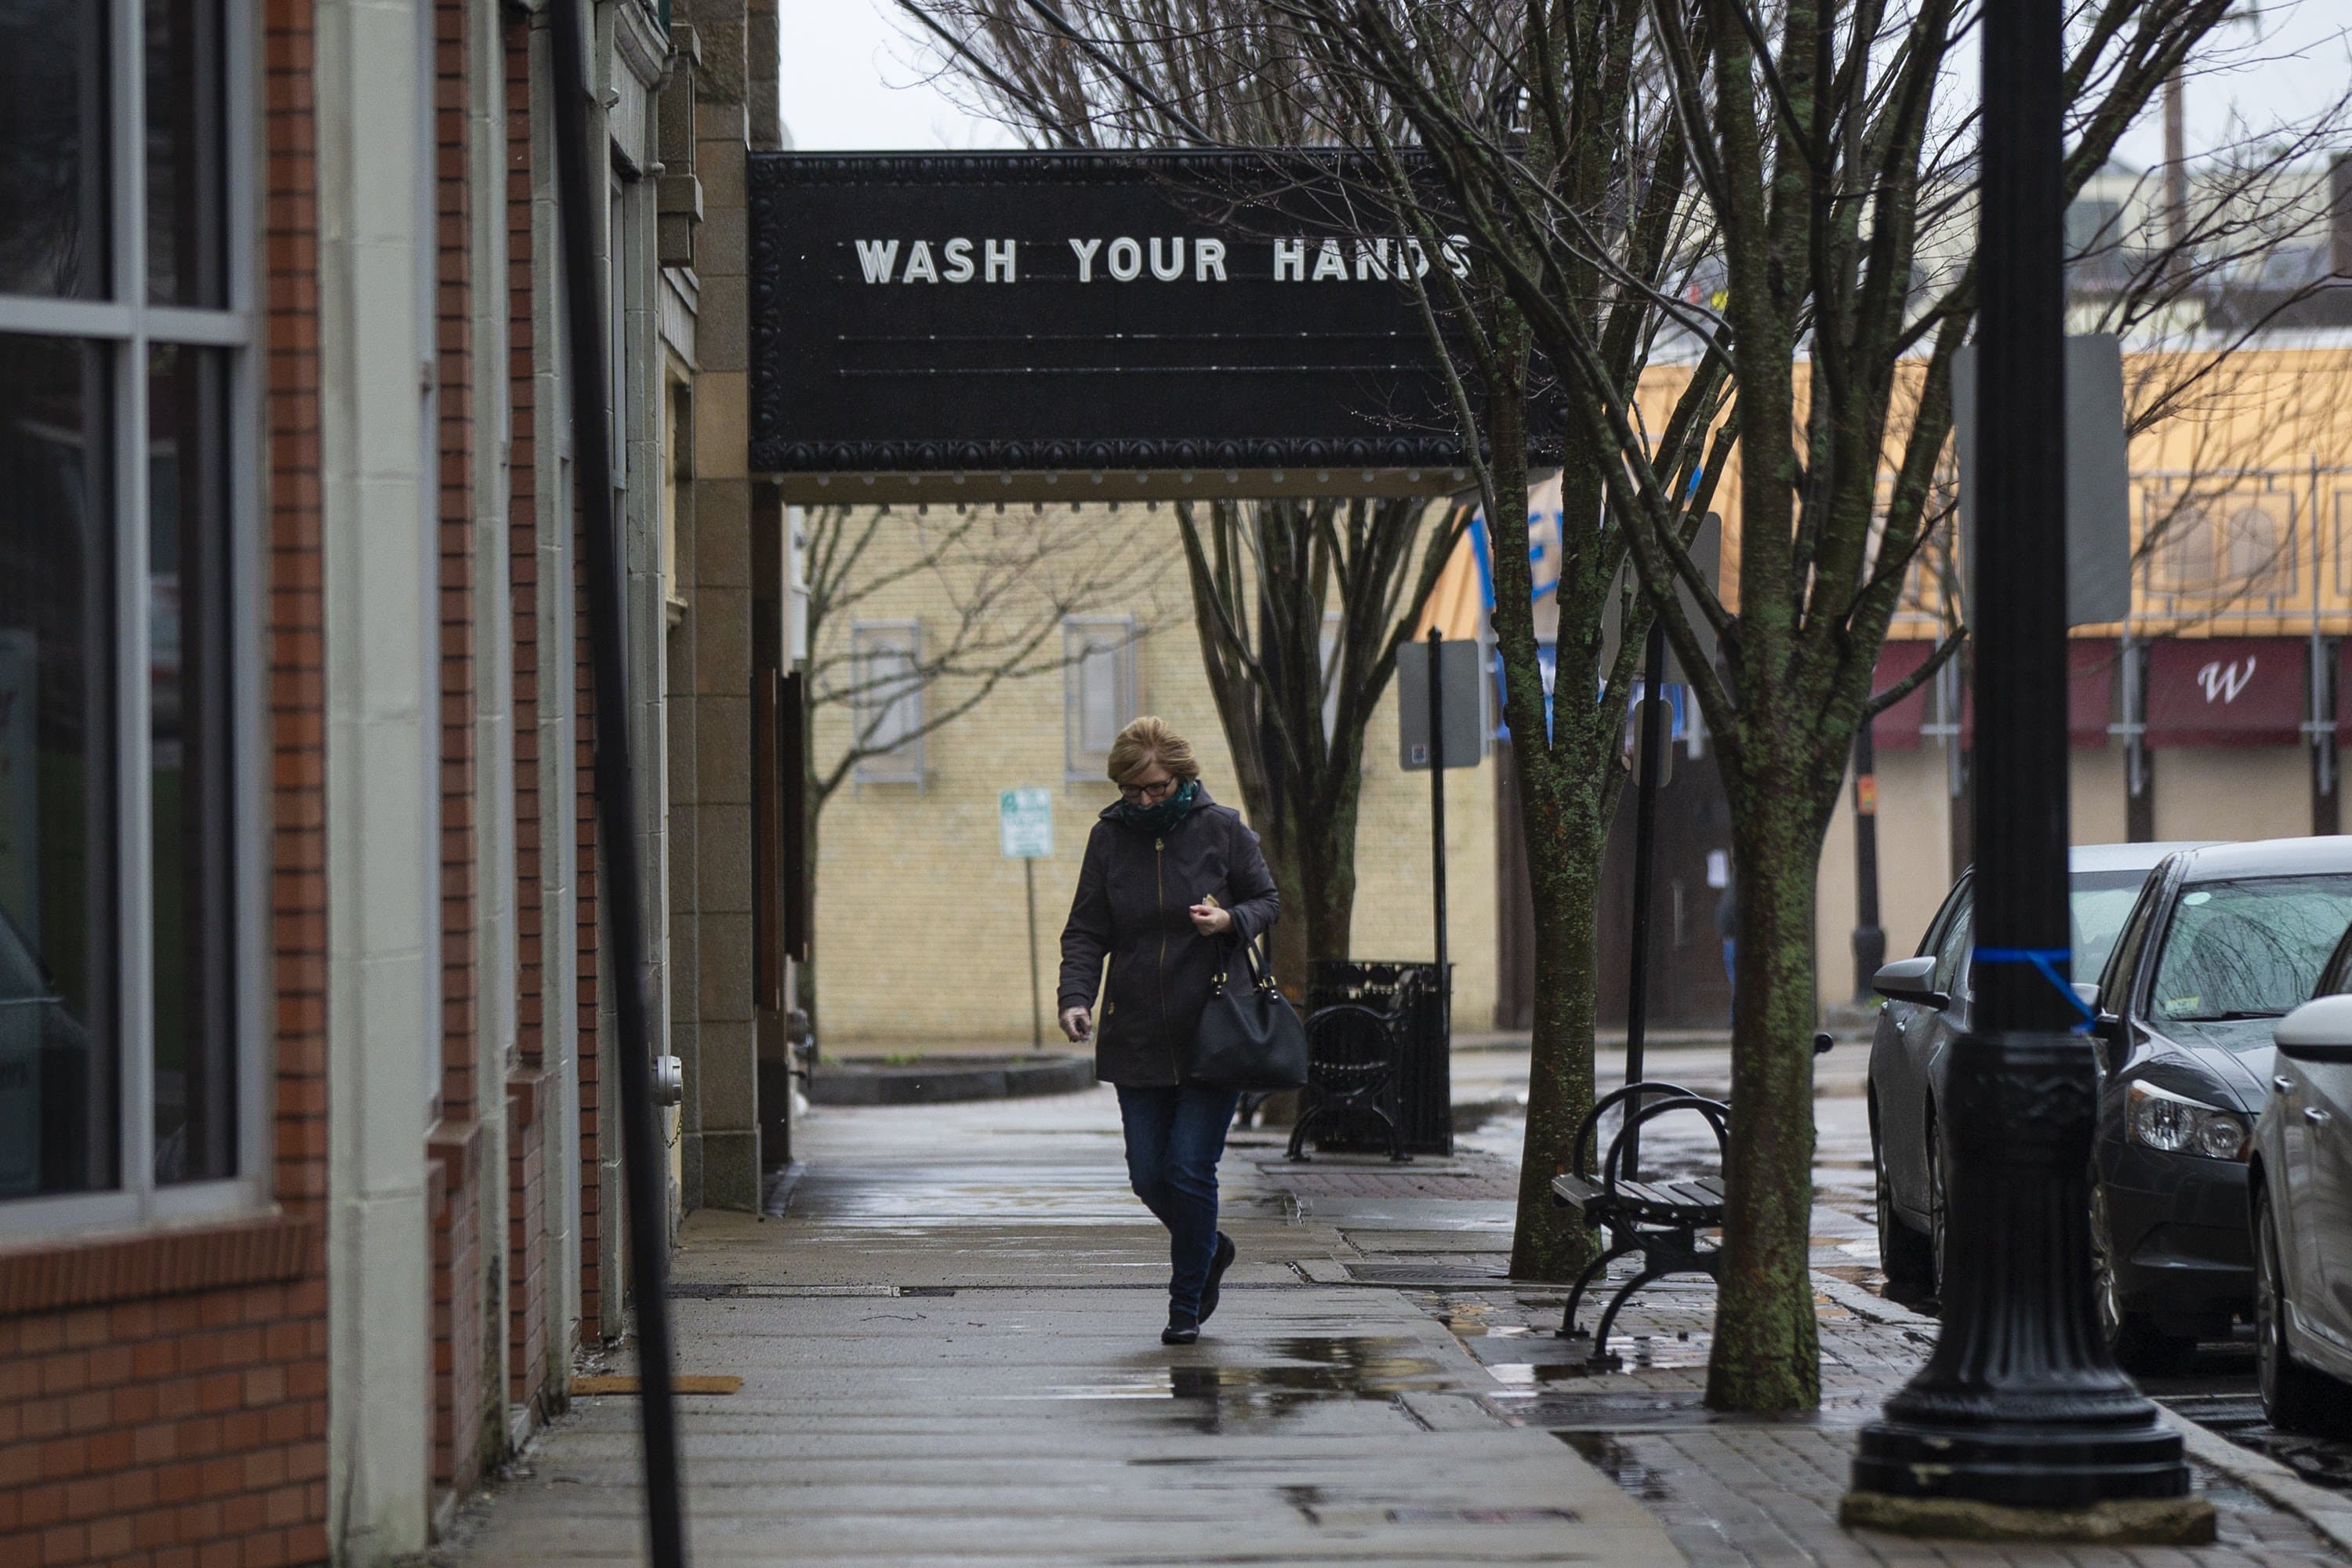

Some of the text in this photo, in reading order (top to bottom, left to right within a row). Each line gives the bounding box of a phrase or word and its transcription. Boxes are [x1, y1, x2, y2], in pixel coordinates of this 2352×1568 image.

[855, 234, 1472, 284] WASH YOUR HANDS
[2197, 654, 2256, 704] W
